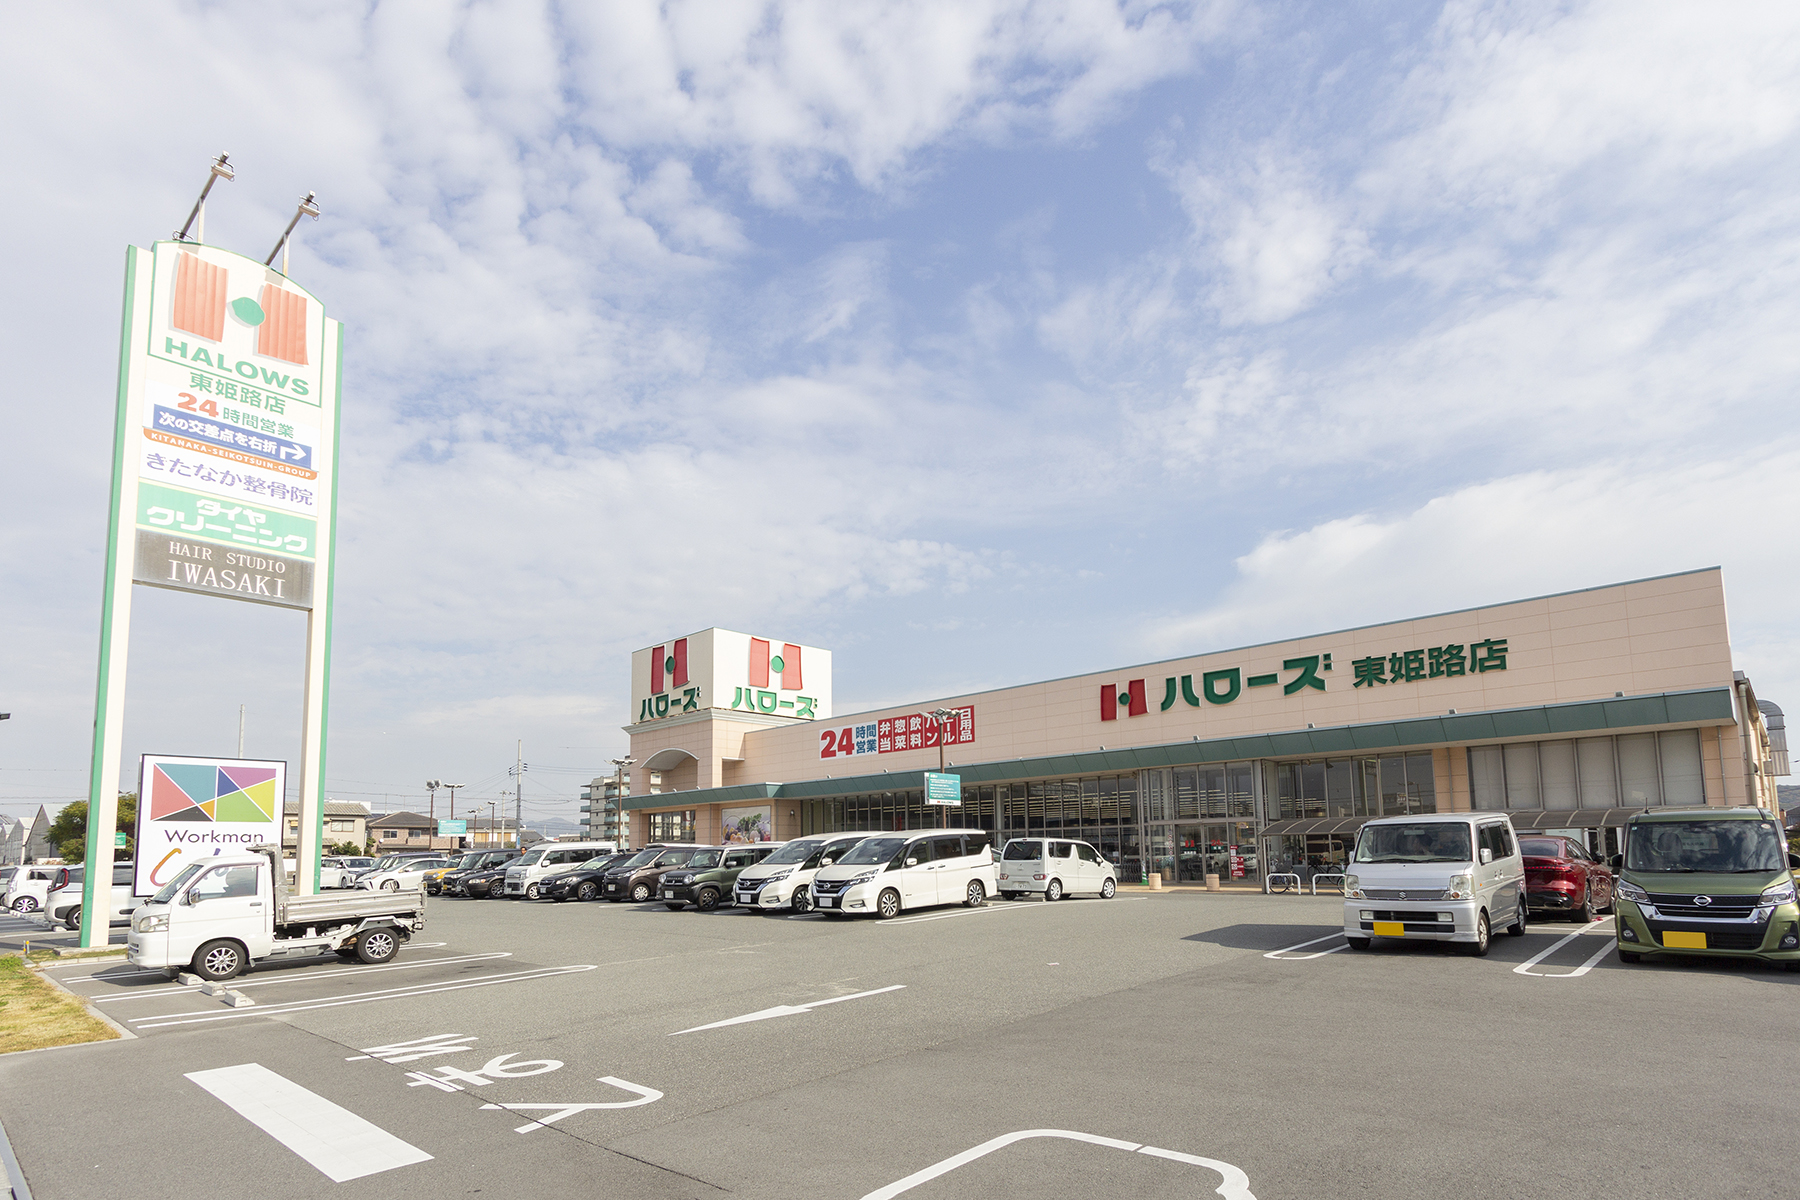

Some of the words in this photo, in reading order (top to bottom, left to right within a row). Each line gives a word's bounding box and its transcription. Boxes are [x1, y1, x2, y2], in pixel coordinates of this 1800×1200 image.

[165, 336, 309, 396] HALOWS
[189, 371, 286, 415] 東姫路店
[158, 411, 277, 455] 次の交差点を右折
[151, 432, 312, 478] KITANAKA-SEIKOTSUIN-GROUP
[146, 453, 313, 505] きたなか整骨院
[146, 505, 308, 552] クリーニング
[169, 541, 212, 561] HAIR
[226, 552, 286, 574] STUDIO
[167, 559, 286, 599] IWASAKI
[1160, 652, 1334, 713] ハローズ
[1351, 638, 1509, 689] 東姫路店
[639, 686, 702, 721] ハローズ
[731, 686, 818, 719] ハローズ
[820, 727, 855, 759] 24
[960, 708, 973, 742] 日用品
[164, 829, 264, 843] Workman
